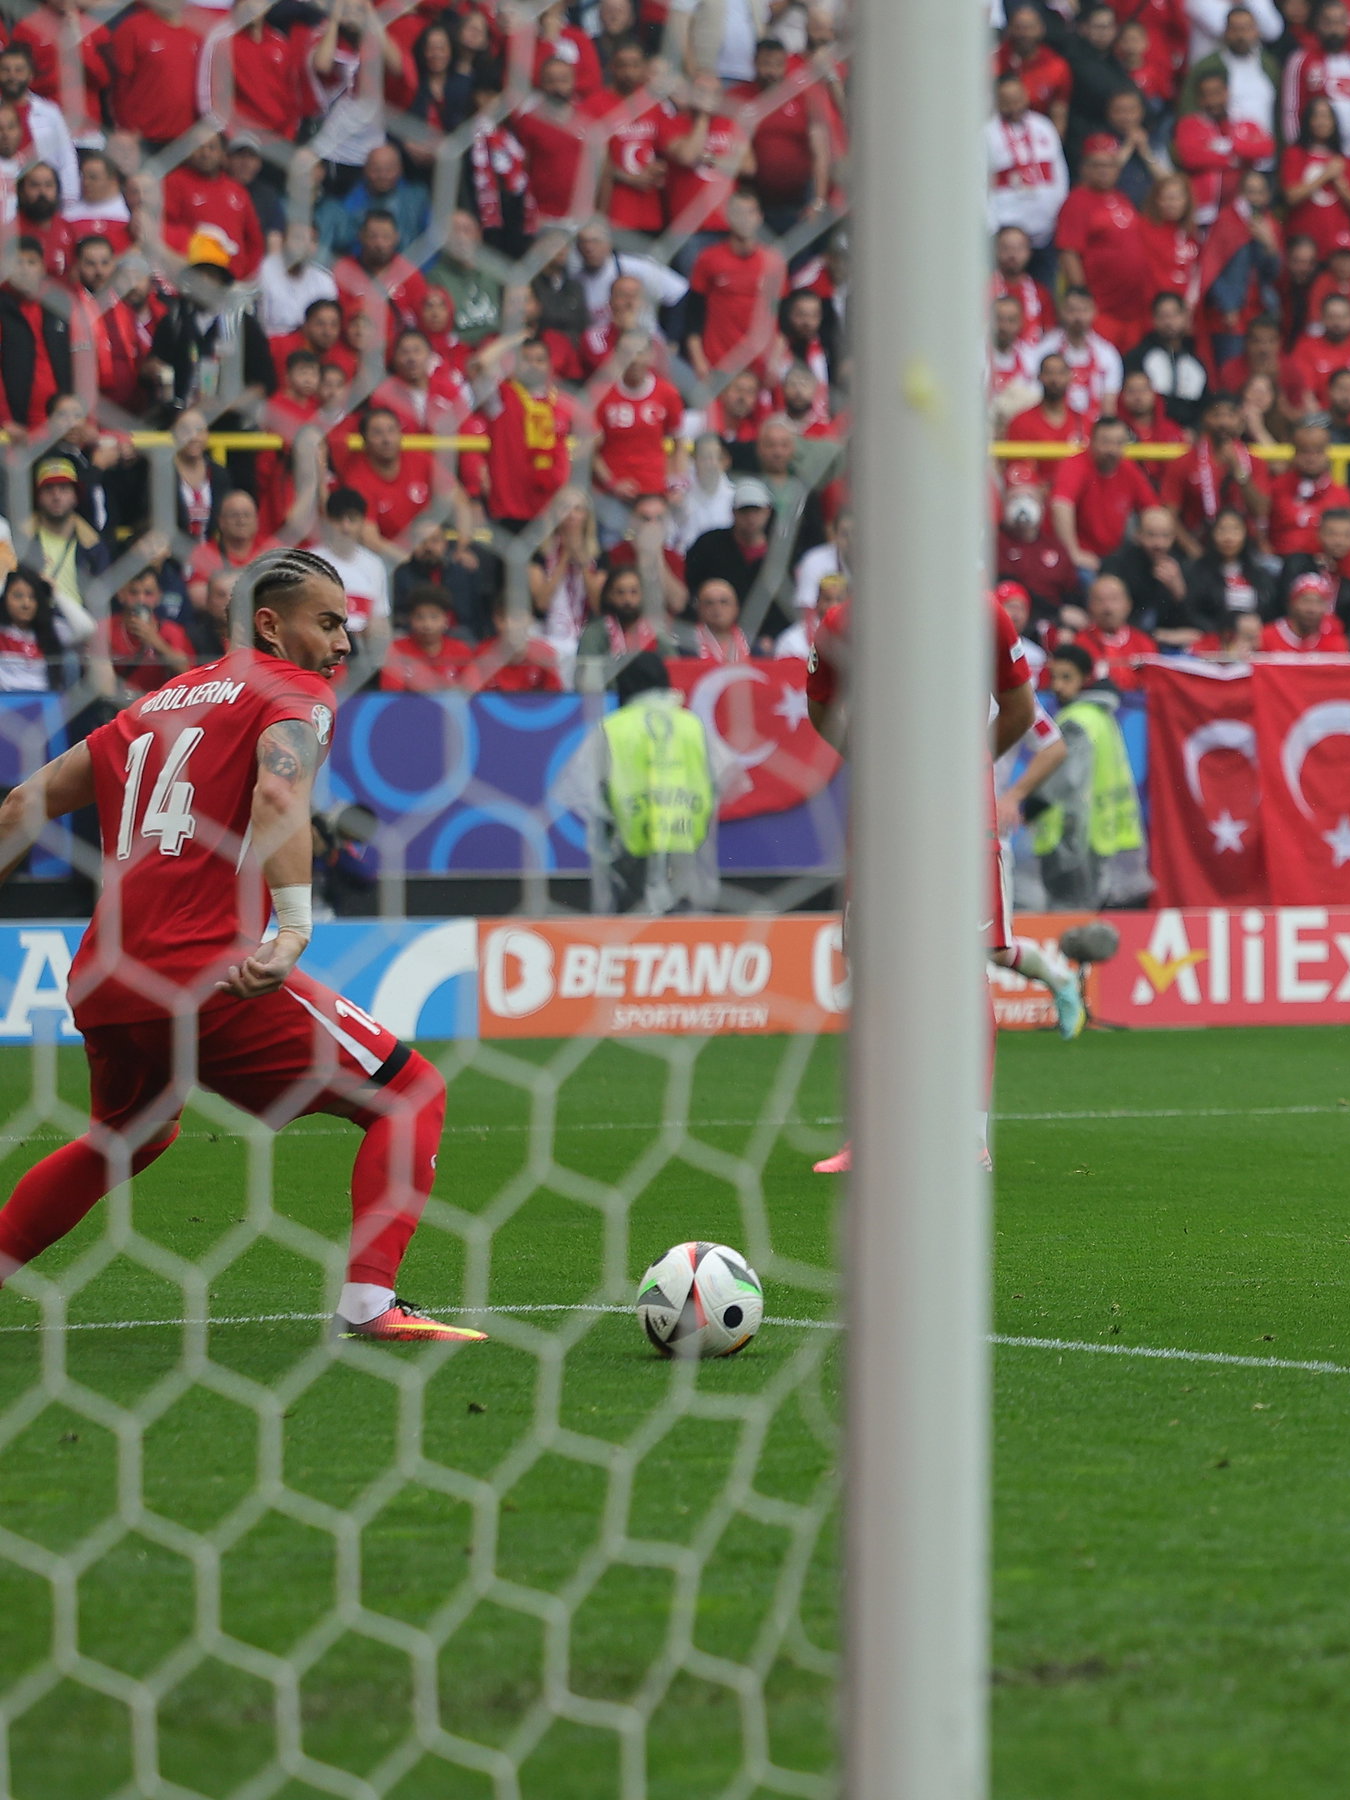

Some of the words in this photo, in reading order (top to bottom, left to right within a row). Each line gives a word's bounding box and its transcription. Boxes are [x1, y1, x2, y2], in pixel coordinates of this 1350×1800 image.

[117, 727, 204, 860] 14
[559, 941, 773, 999] BETANO
[610, 1005, 769, 1031] SPORTWETTEN
